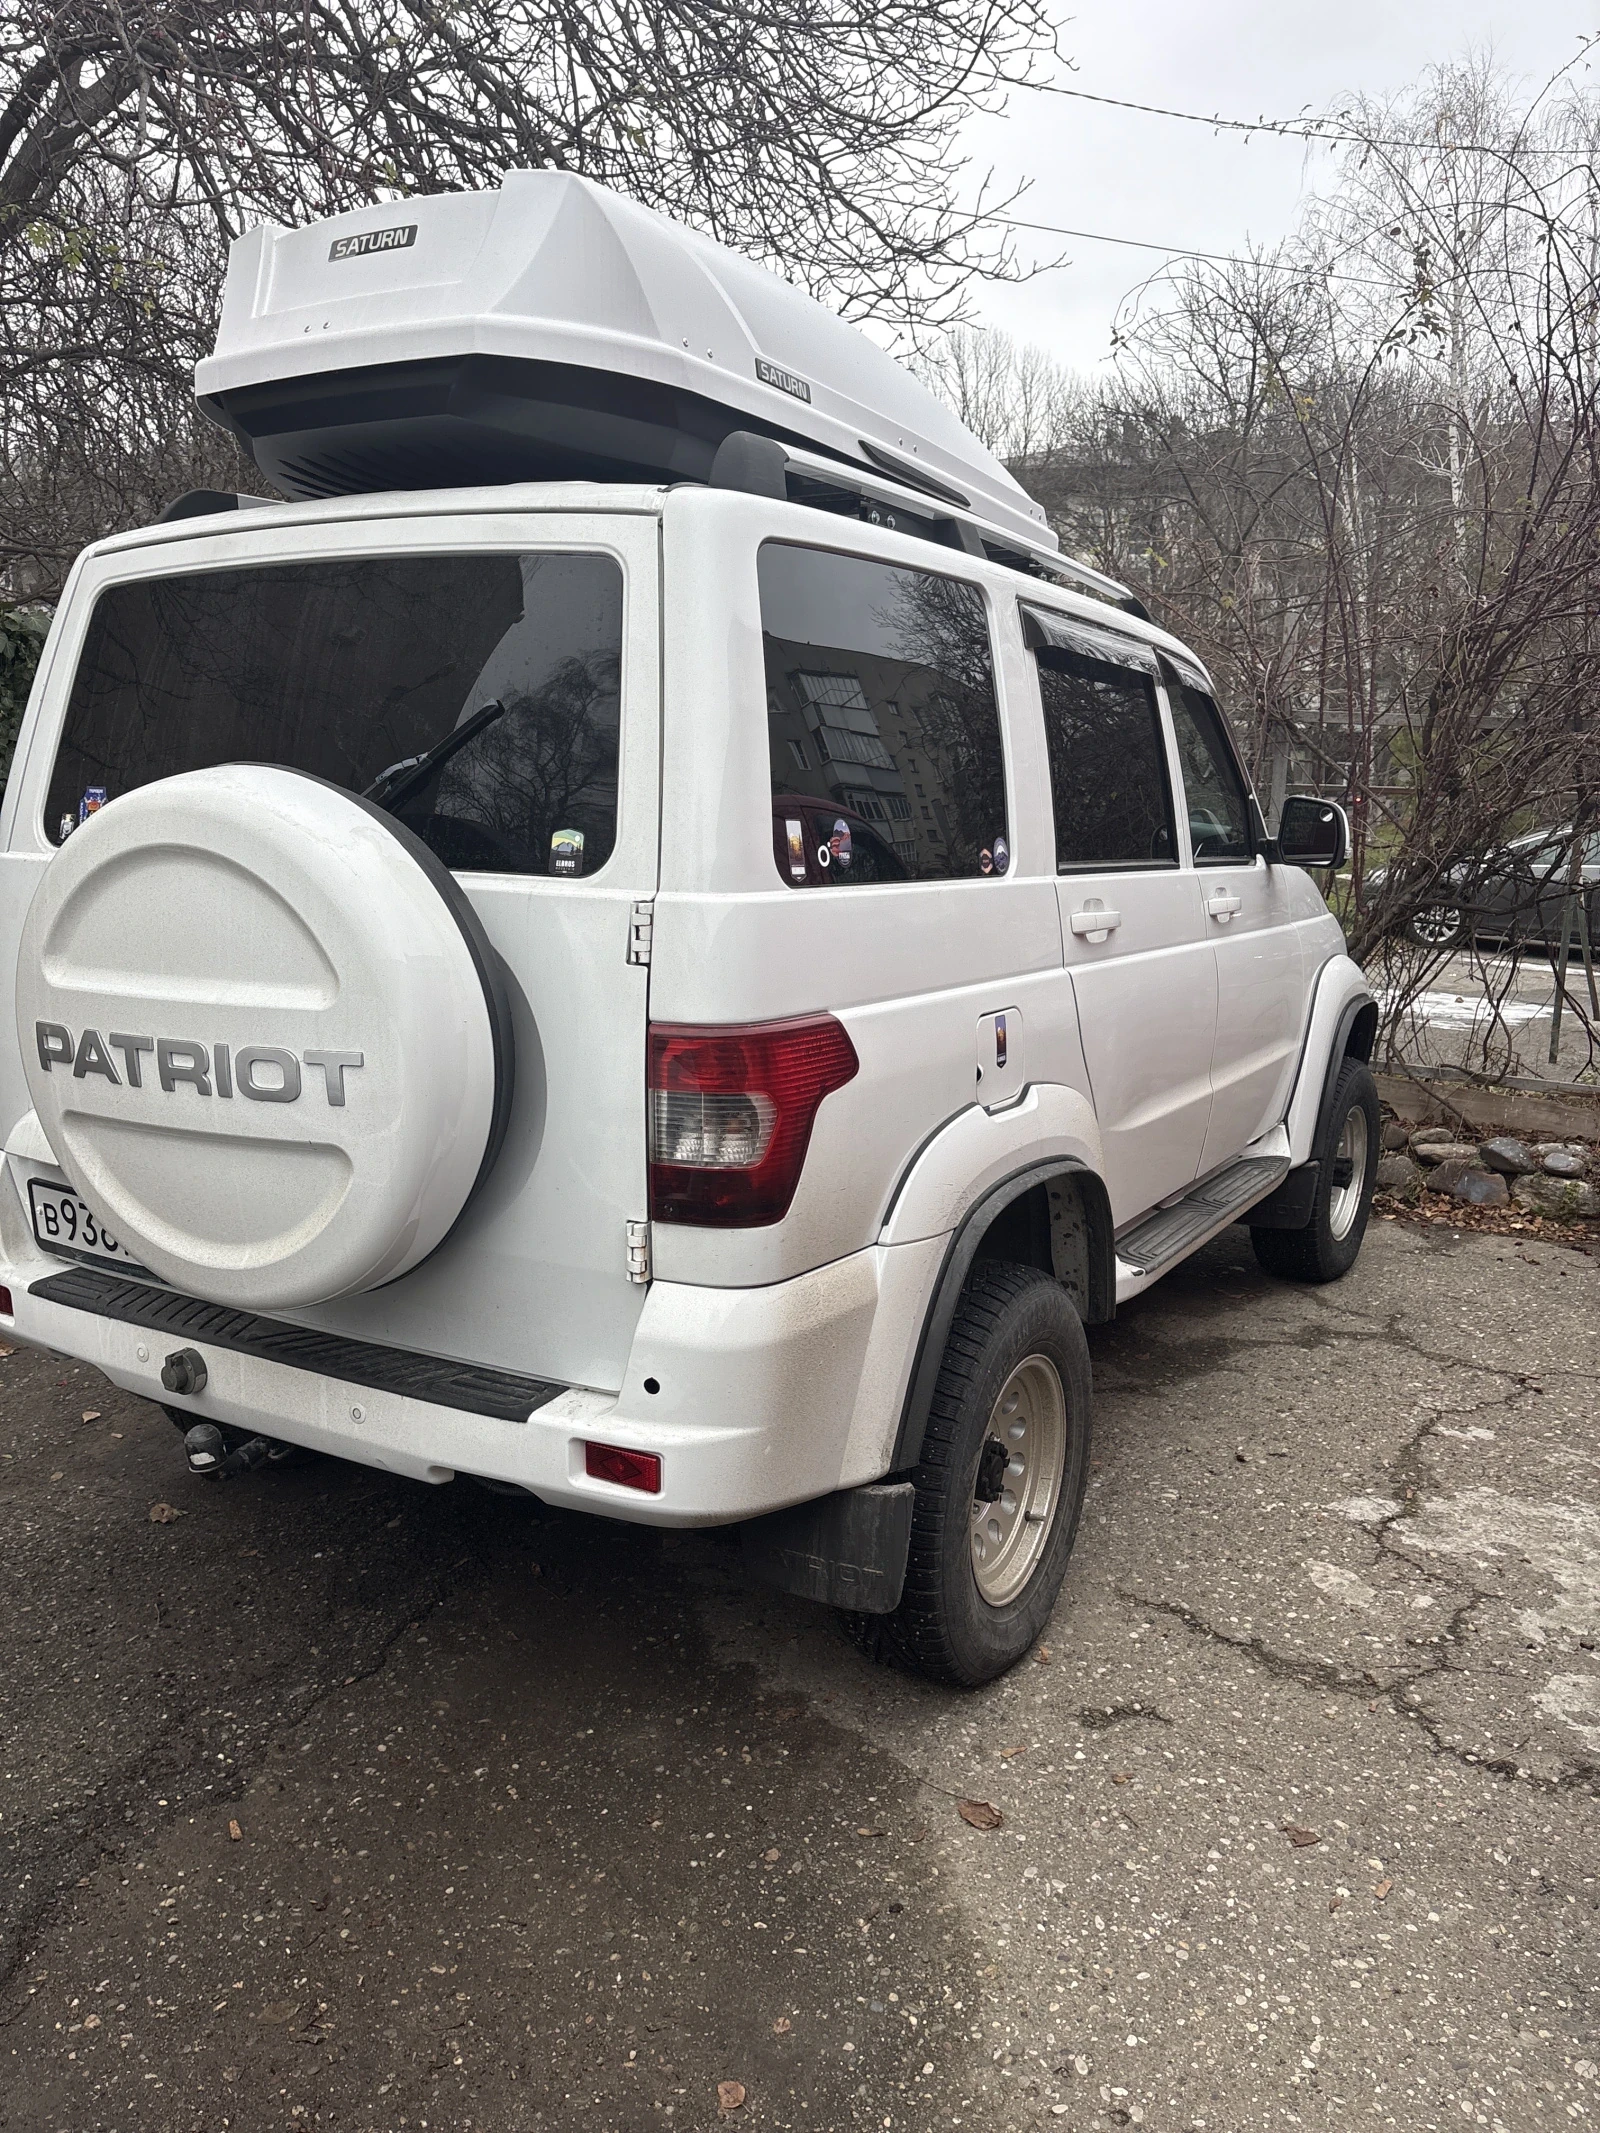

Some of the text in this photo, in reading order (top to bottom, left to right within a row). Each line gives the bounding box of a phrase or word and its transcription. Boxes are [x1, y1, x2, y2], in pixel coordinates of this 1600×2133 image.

[335, 228, 409, 257] SATURN
[761, 363, 807, 399] SATURN
[36, 1020, 364, 1106] PATRIOT
